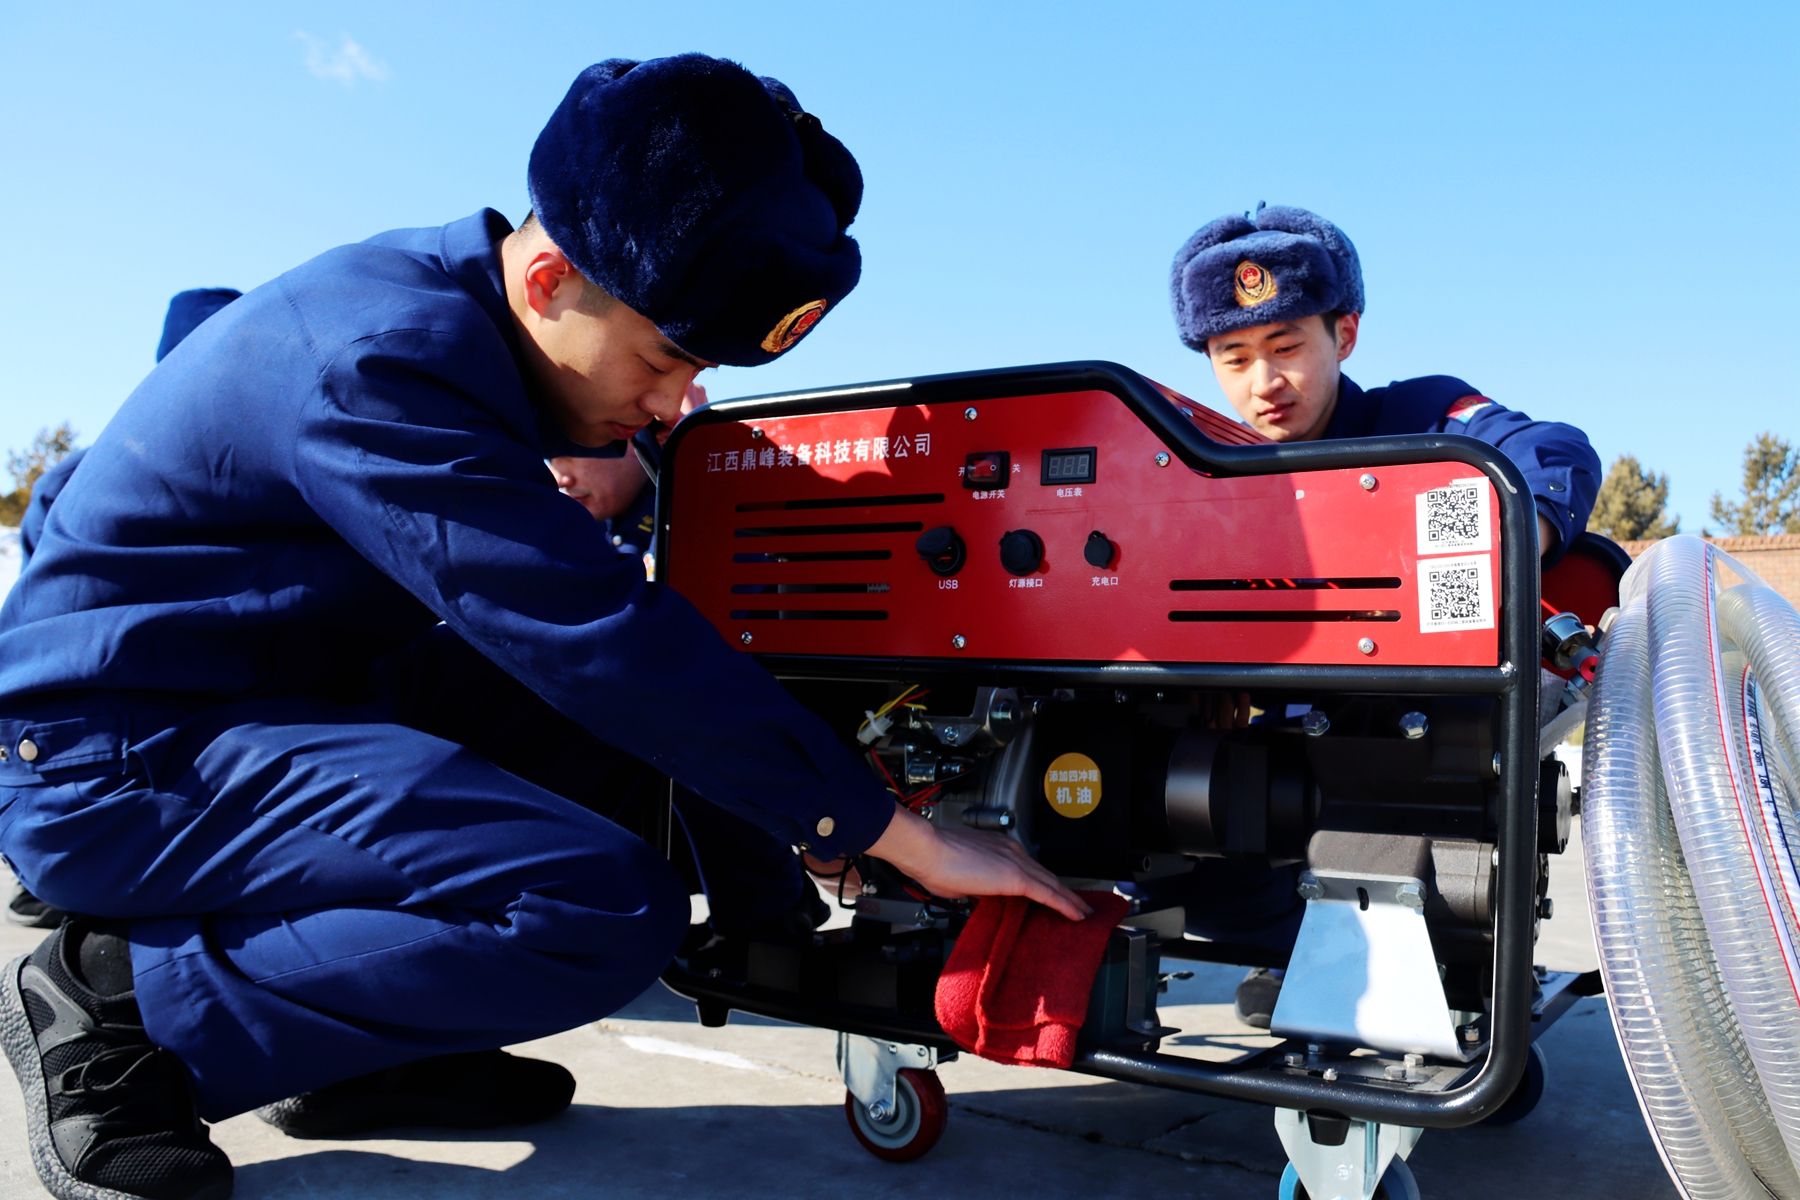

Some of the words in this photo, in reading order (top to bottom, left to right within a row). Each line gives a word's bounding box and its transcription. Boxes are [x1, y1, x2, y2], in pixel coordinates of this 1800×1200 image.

[707, 433, 930, 473] 江西鼎峰装备科技有限公司
[1012, 463, 1021, 473] 关
[972, 489, 1005, 500] 电源开关
[1056, 487, 1083, 498] 电压表
[938, 579, 959, 590] USB
[1008, 578, 1043, 588] 灯源接口
[1091, 576, 1119, 587] 充电口
[1049, 769, 1099, 782] 添加四冲程
[1056, 786, 1093, 804] 机油
